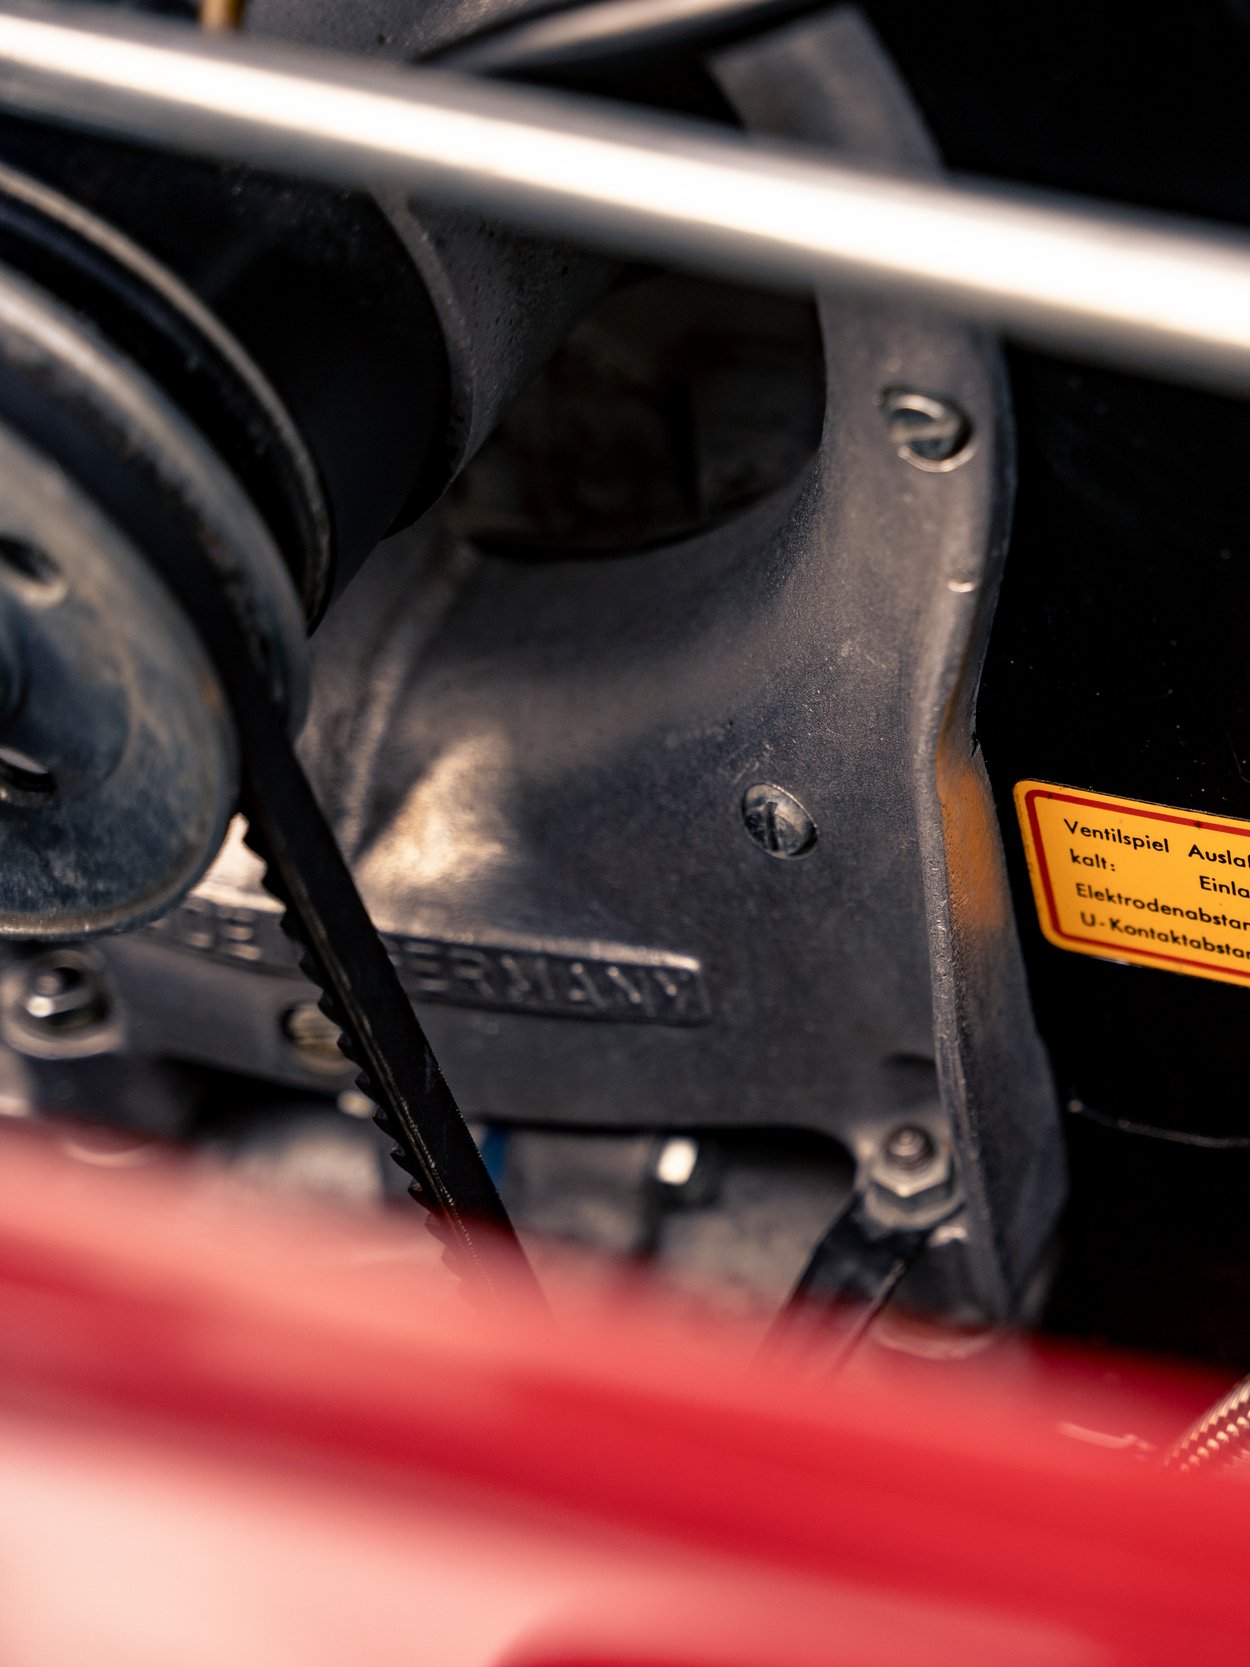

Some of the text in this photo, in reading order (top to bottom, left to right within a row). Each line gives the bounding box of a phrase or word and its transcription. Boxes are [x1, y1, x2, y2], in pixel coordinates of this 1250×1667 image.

[1063, 818, 1170, 853] Ventilspiel
[1069, 848, 1116, 872] kalt:
[386, 938, 694, 1018] ERMANY
